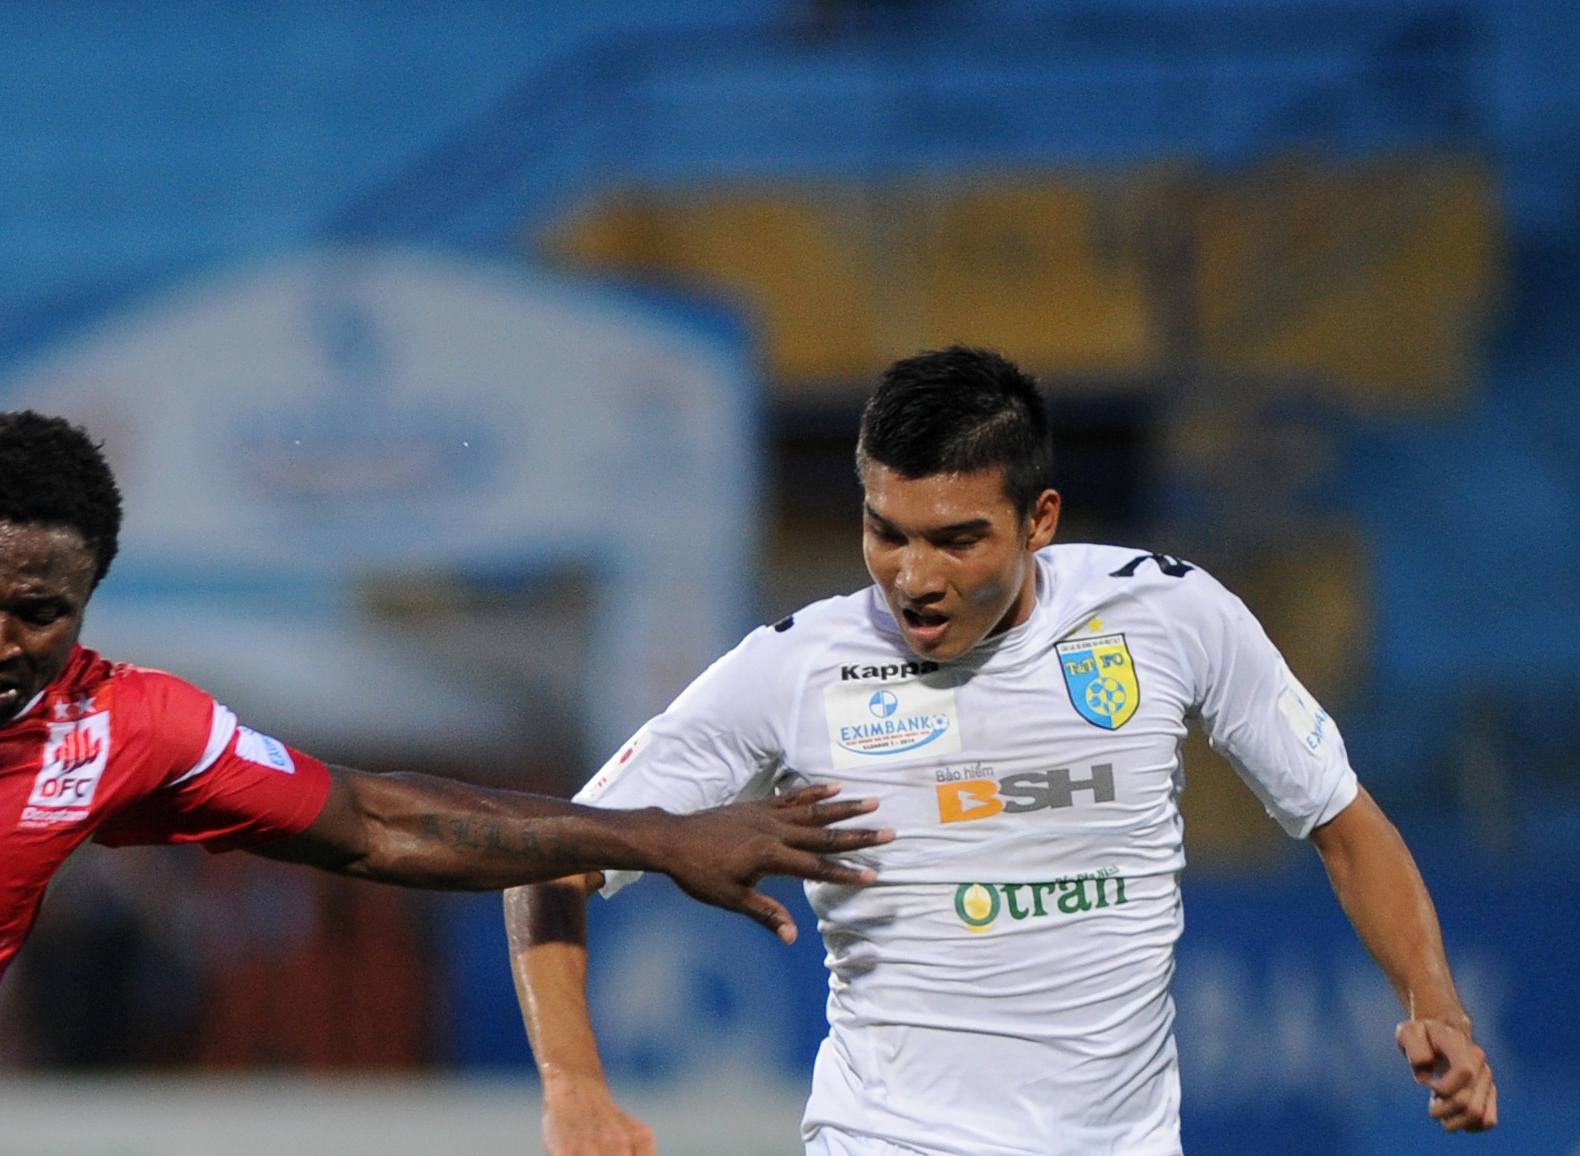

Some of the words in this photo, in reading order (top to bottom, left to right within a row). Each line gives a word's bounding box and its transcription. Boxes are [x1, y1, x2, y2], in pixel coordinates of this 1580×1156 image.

[841, 661, 939, 681] Kappa
[840, 716, 932, 741] EXIMBANK
[936, 763, 1116, 825] BSH
[955, 875, 1129, 929] Otran
